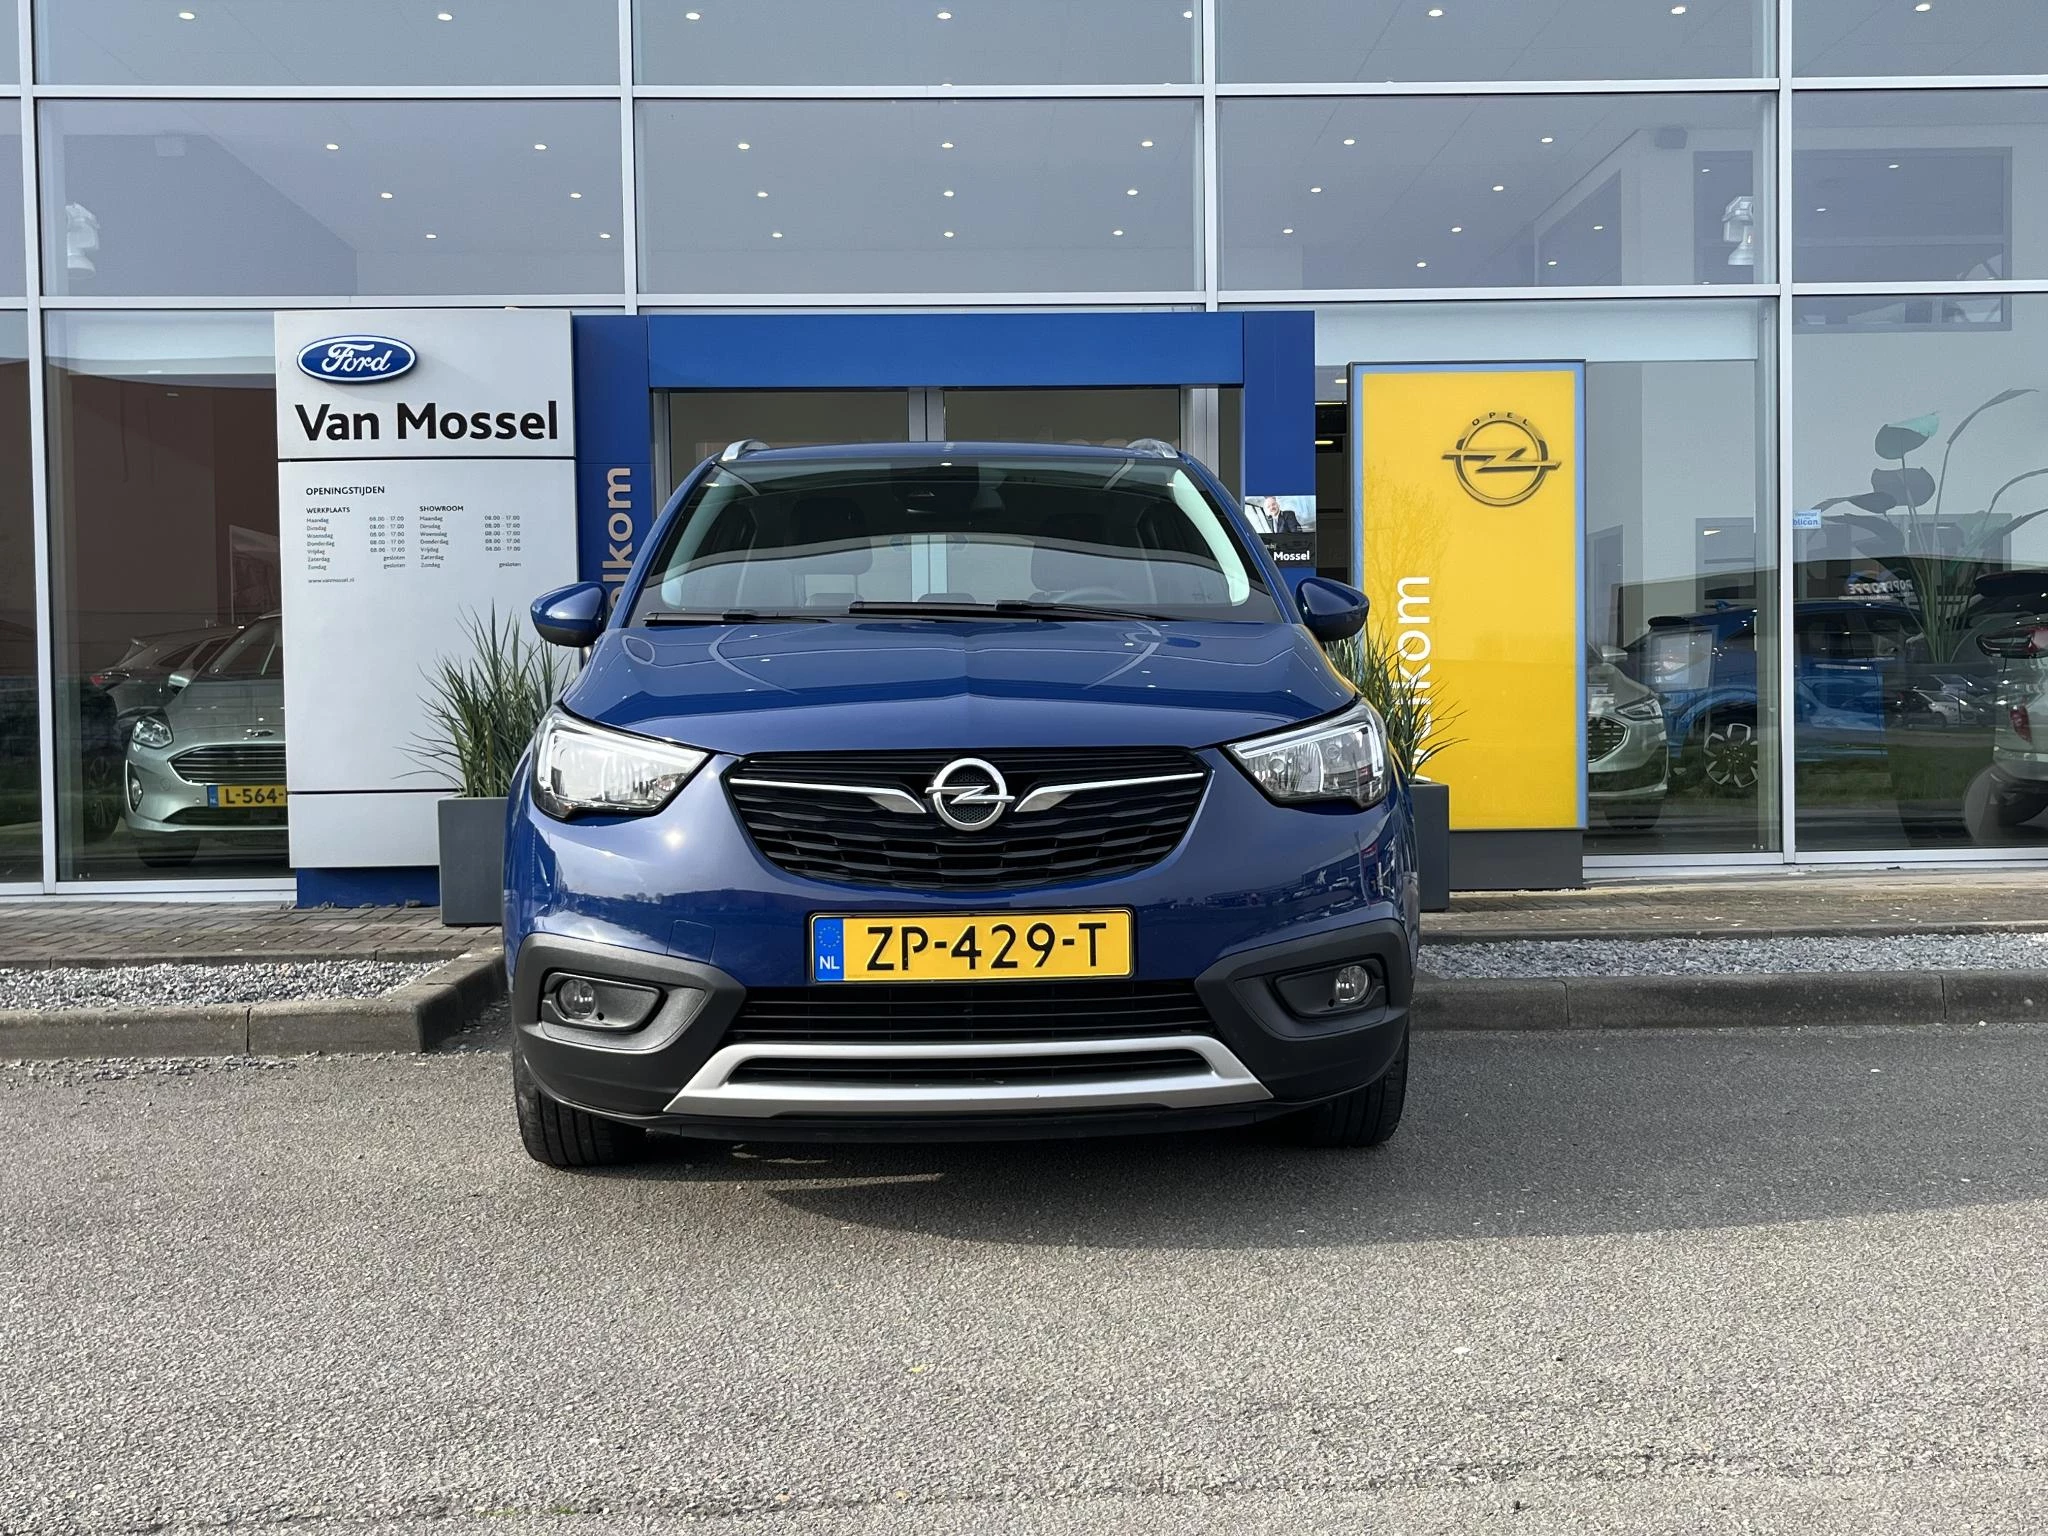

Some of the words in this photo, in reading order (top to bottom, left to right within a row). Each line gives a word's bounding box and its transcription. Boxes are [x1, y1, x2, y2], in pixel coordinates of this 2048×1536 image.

[321, 343, 392, 372] Ford
[295, 403, 380, 441] Van
[397, 400, 558, 440] Mossel
[1471, 411, 1529, 426] OPEL
[306, 486, 385, 496] OPENINGSTIJDEN
[602, 467, 633, 609] lkom
[1273, 550, 1310, 561] Mossel
[225, 788, 288, 804] L-564-
[866, 921, 1107, 972] ZP-429-T
[819, 955, 840, 971] NL
